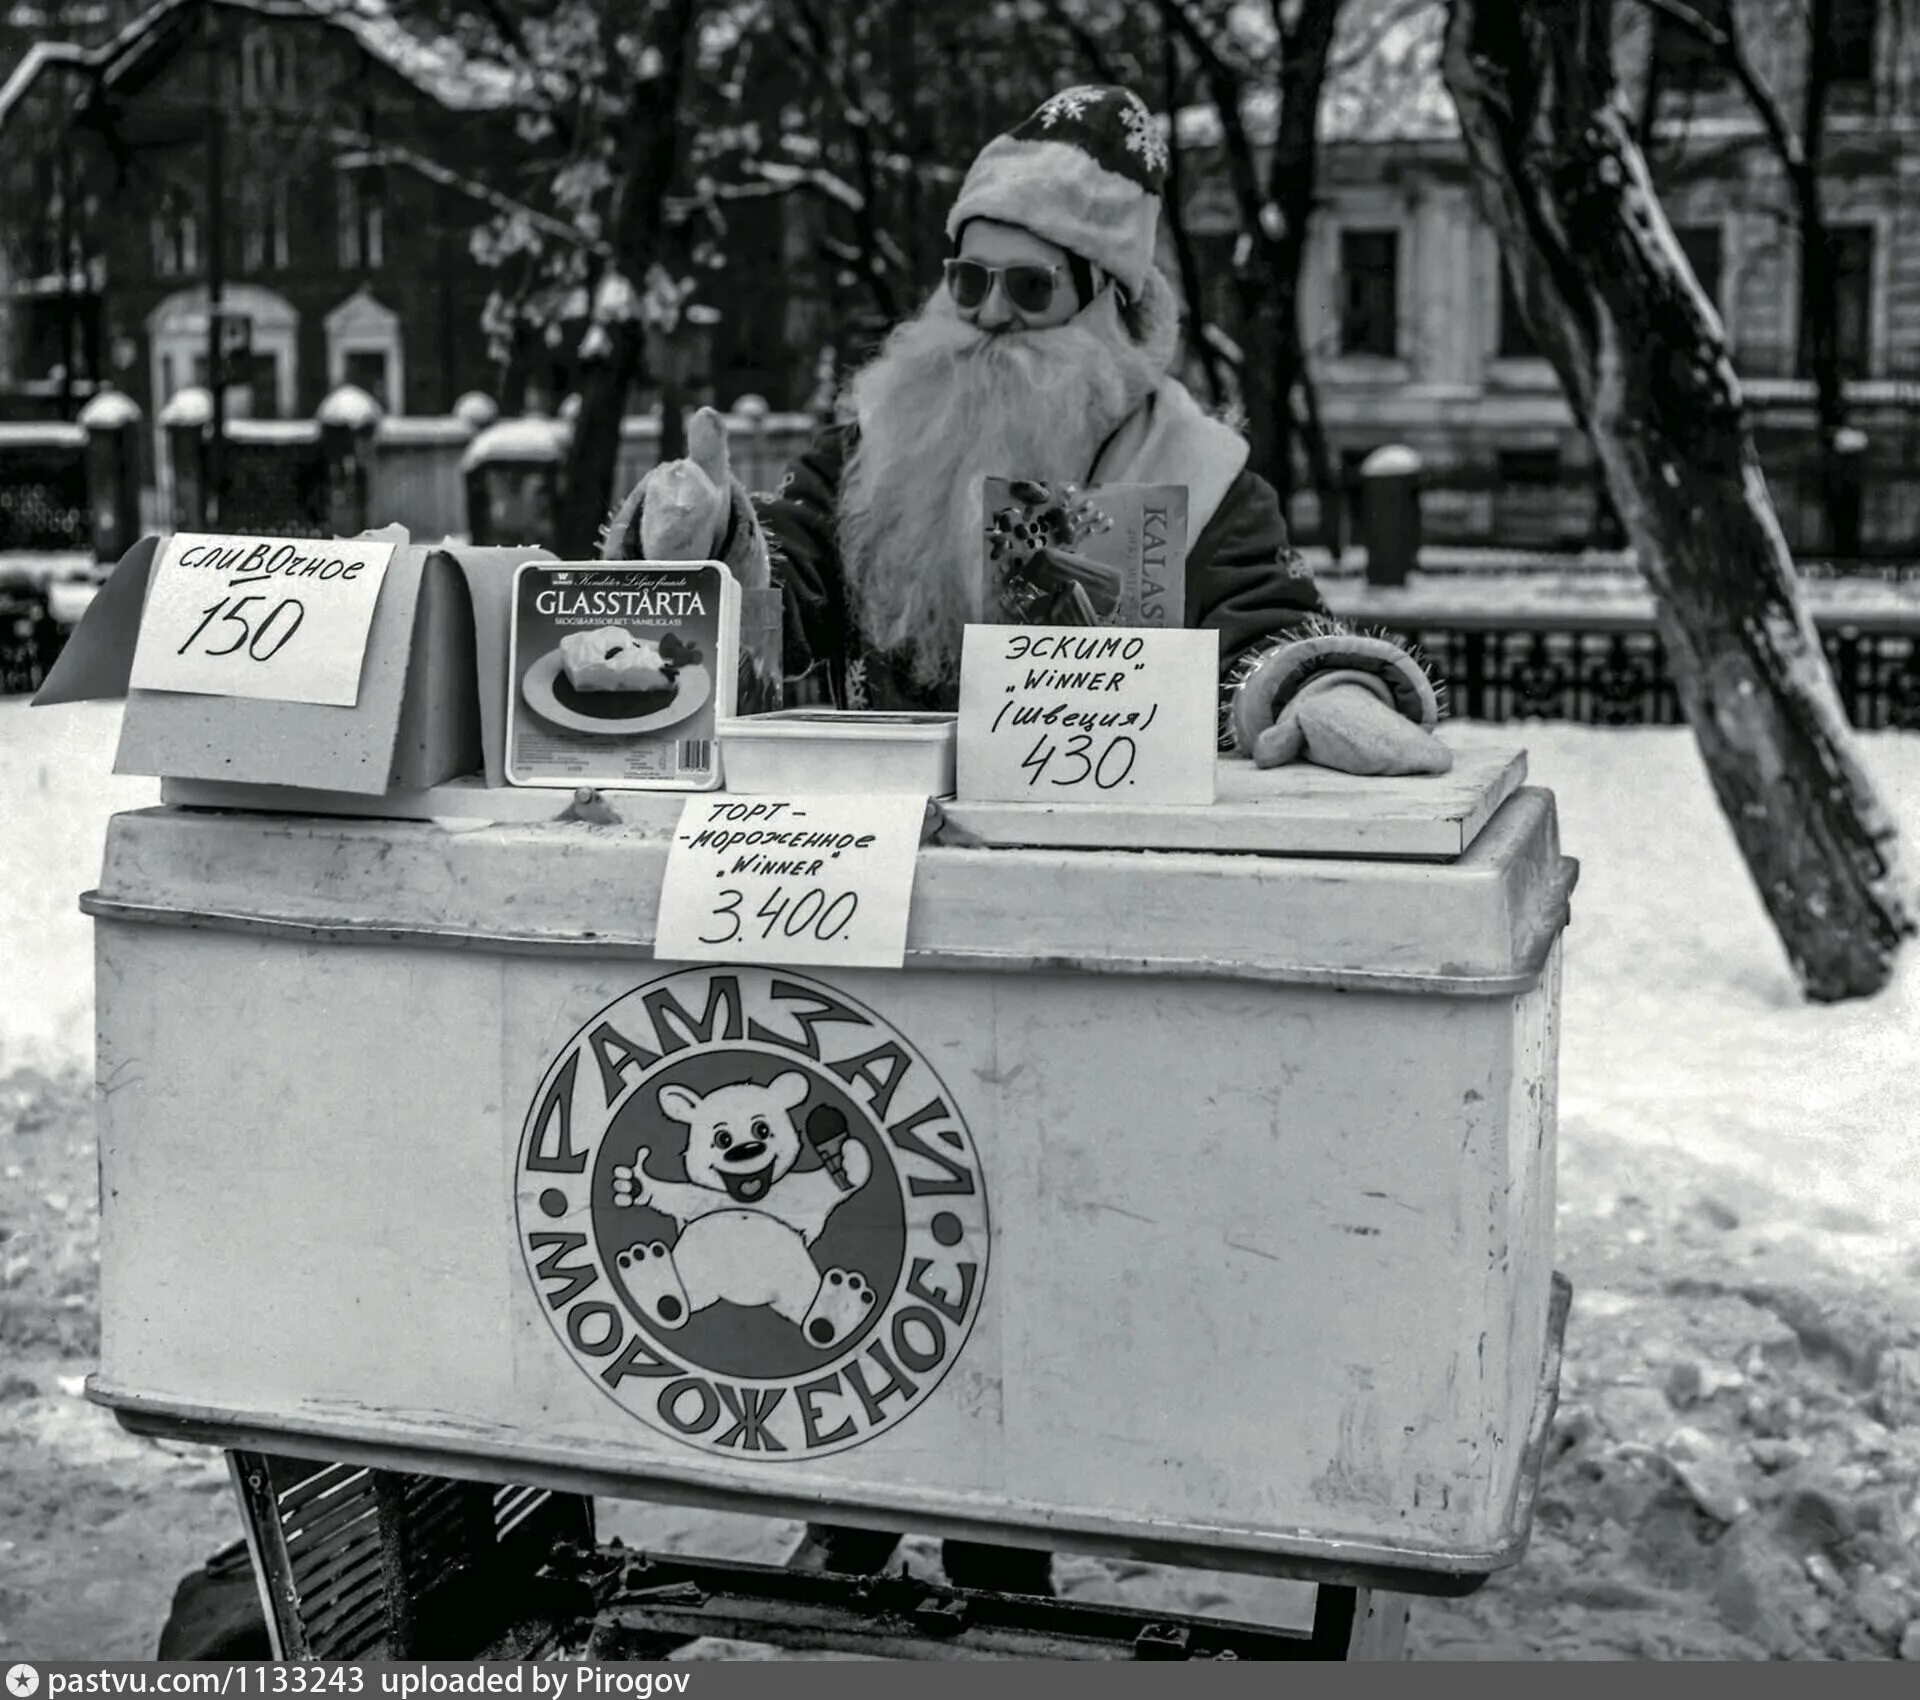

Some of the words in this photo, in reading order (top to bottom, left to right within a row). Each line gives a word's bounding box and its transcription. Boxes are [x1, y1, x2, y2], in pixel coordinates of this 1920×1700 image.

[1140, 504, 1168, 628] KALAS
[178, 597, 304, 661] 150
[535, 588, 706, 616] GLASSTÅRTA
[1005, 635, 1144, 660] ЭСКИМО
[1021, 733, 1136, 789] 430.
[698, 886, 858, 943] 3.400.
[528, 1232, 978, 1452] МОРОЖЕНОЕ
